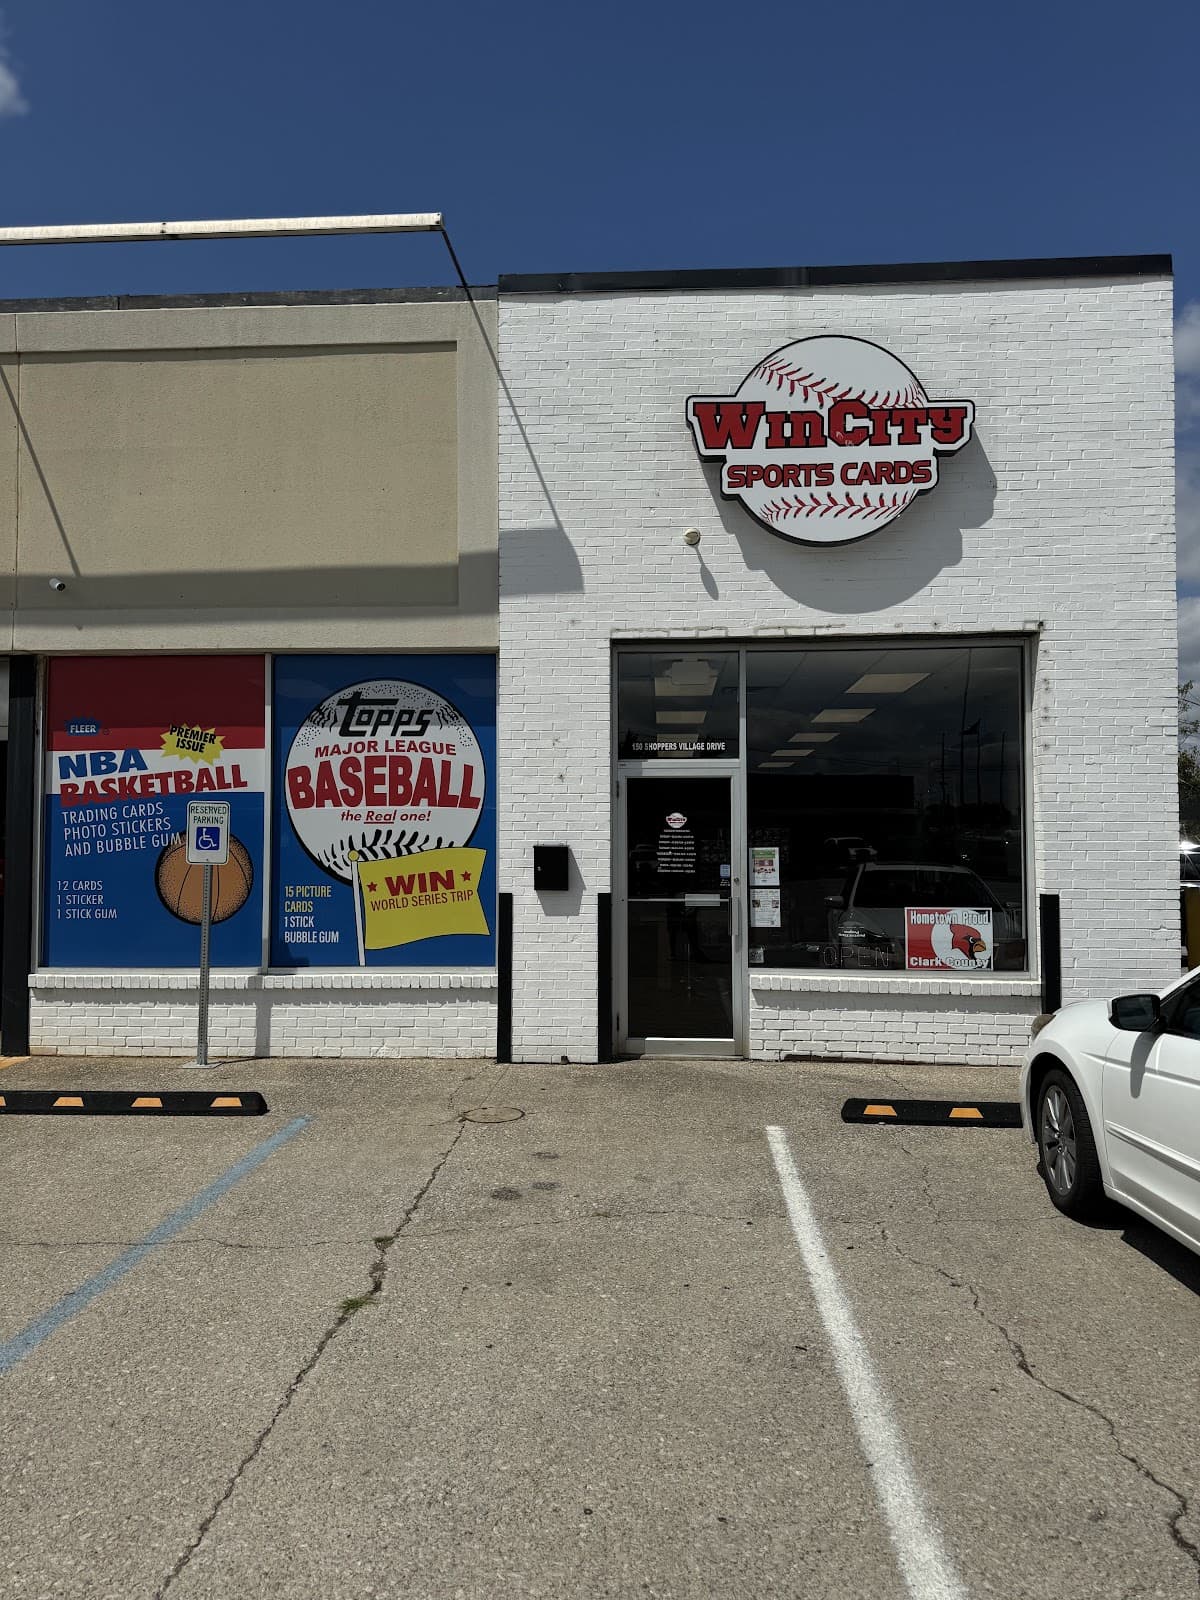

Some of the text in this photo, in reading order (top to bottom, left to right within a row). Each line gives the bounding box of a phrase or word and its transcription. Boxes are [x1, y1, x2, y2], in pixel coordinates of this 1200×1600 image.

[727, 460, 931, 488] SPORTS CARDS
[70, 724, 96, 733] FLEER
[169, 724, 216, 744] PREMIER
[176, 738, 206, 753] ISSUE
[314, 739, 456, 758] MAJOR LEAGUE
[632, 742, 726, 751] 150 SHOPPERS VILLAGE DRIVE
[58, 748, 148, 780] NBA
[60, 764, 248, 807] BASKETBALL
[287, 755, 482, 810] BASEBALL
[62, 802, 163, 825] TRADING CARDS
[190, 806, 227, 815] RESERVED
[341, 810, 431, 823] the Real one!
[193, 815, 224, 825] PARKING
[64, 817, 171, 841] PHOTO STICKERS
[65, 832, 182, 857] AND BUBBLE GUM
[57, 880, 103, 891] 12 CARDS
[384, 870, 455, 896] WIN
[284, 886, 332, 898] 15 PICTURE
[57, 895, 104, 905] 1 STICKER
[284, 901, 313, 913] CARDS
[370, 890, 474, 912] WORLD SERIES TRIP
[57, 909, 118, 919] 1 STICK GUM
[910, 910, 989, 926] Hometown Proud
[284, 916, 314, 928] 1 STICK
[284, 931, 339, 943] BUBBLE GUM
[823, 947, 889, 967] OPEN
[910, 957, 989, 969] Clark County
